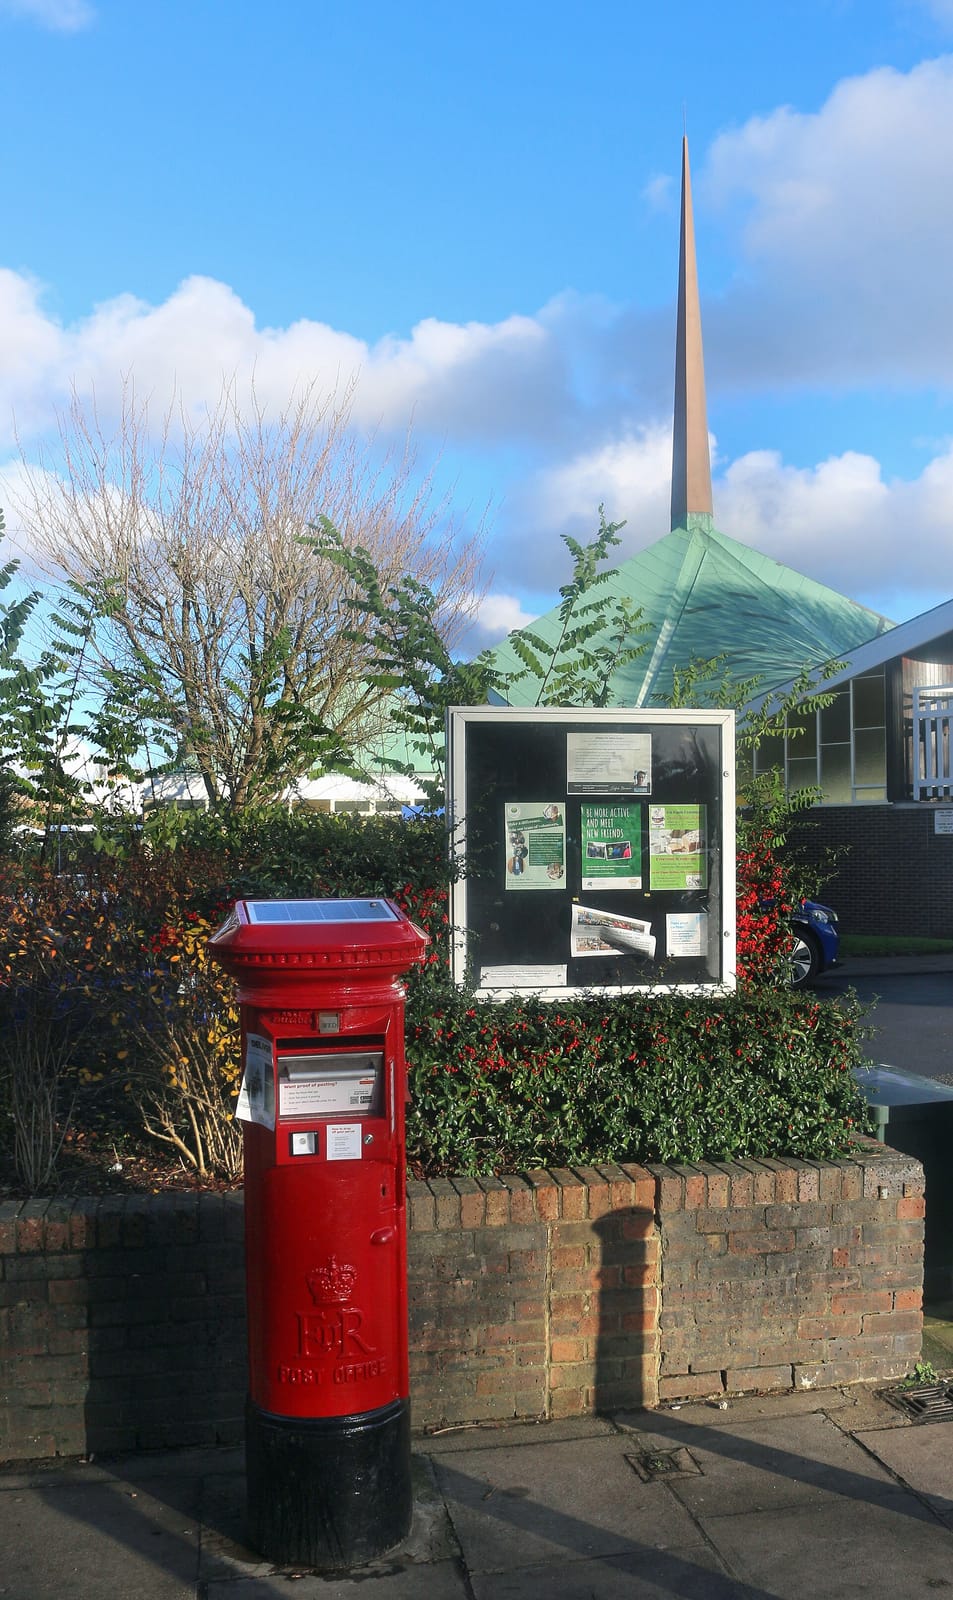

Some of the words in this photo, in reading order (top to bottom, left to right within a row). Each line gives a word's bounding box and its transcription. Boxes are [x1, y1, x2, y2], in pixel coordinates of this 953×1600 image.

[586, 808, 593, 817] BE
[594, 808, 608, 817] MORE
[610, 808, 630, 817] ACTIVE
[586, 818, 599, 828] AND
[600, 818, 614, 828] MEET
[586, 828, 599, 839] NEW
[601, 828, 624, 839] FRIENDS
[279, 1365, 321, 1385] POST
[333, 1358, 385, 1385] OFFICE
